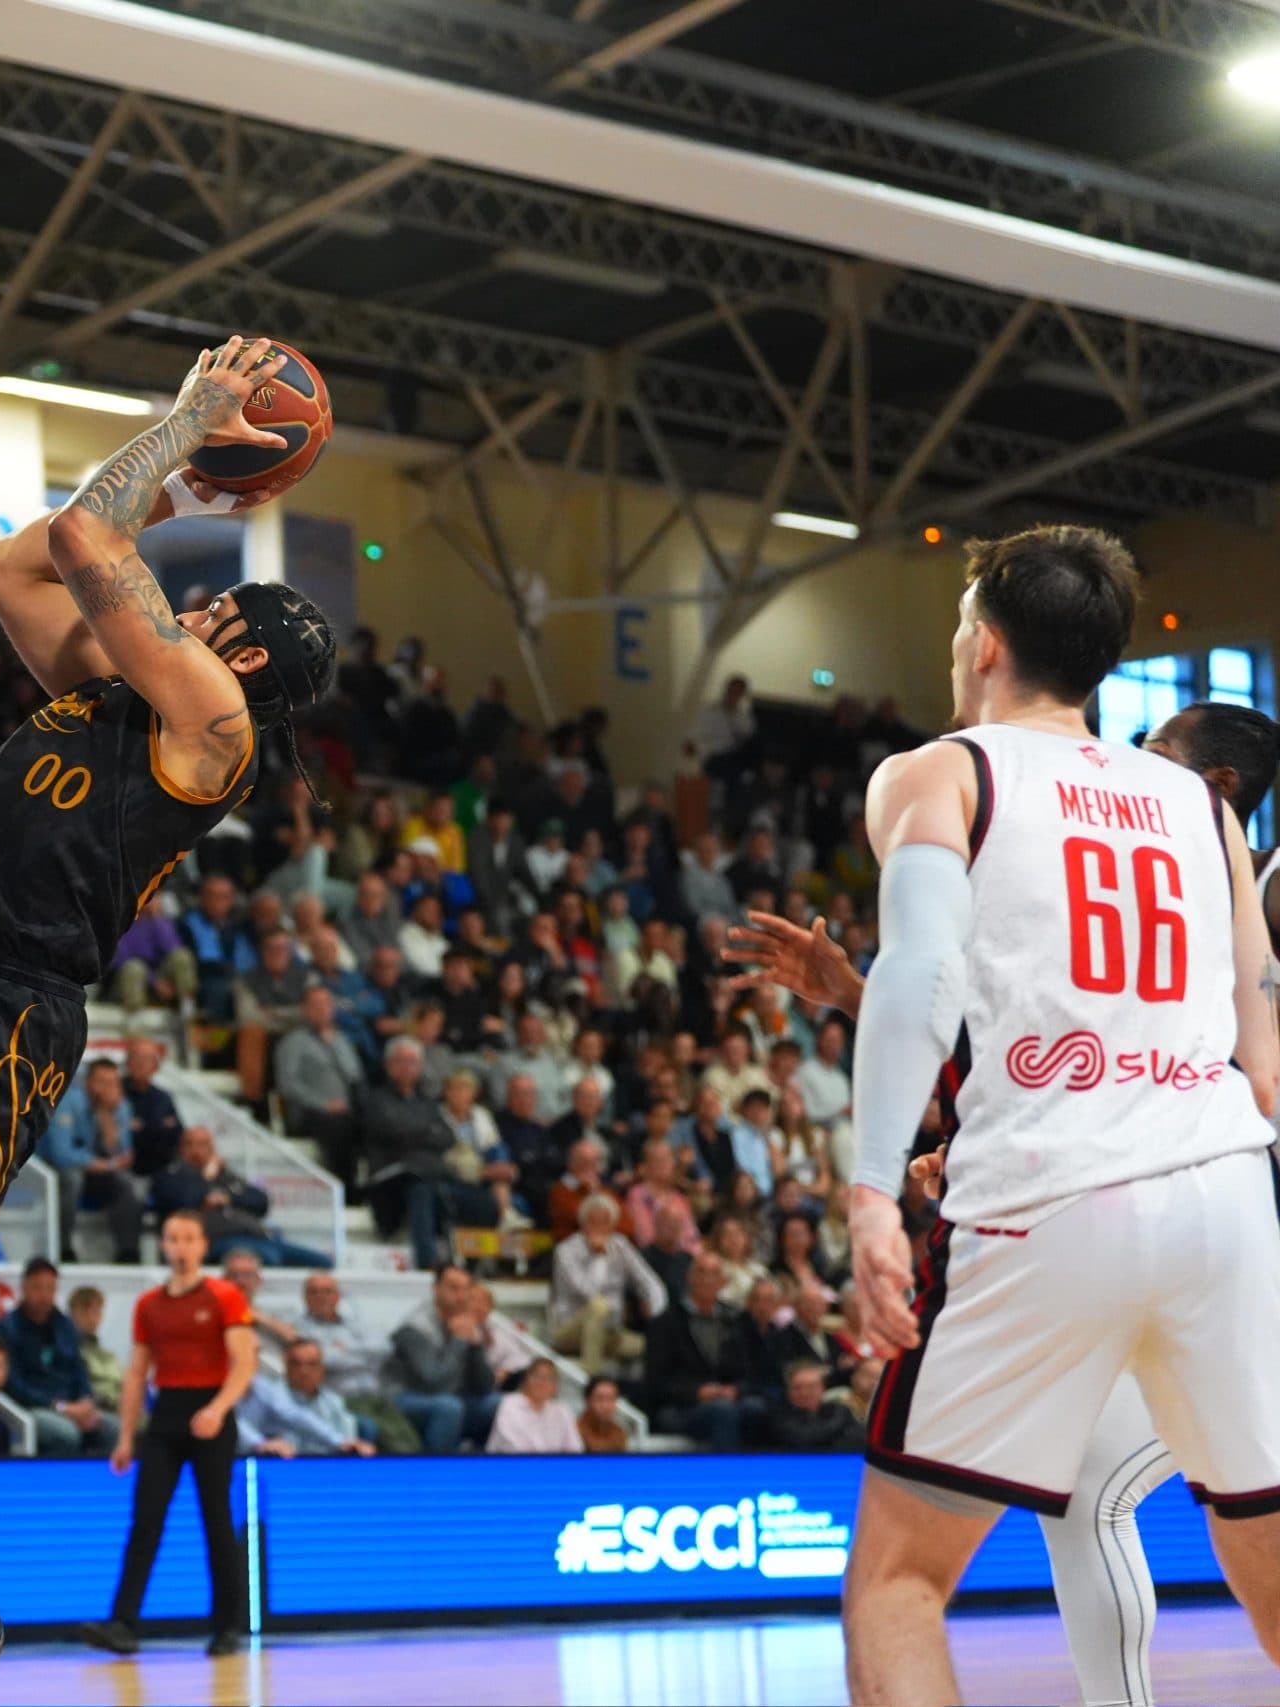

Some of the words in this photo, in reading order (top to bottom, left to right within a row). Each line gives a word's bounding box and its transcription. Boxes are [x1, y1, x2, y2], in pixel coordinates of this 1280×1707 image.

[23, 753, 93, 810] 00
[1055, 780, 1172, 838] MEYNIEL
[1062, 836, 1188, 1004] 66
[556, 1499, 756, 1573] #ESCCi
